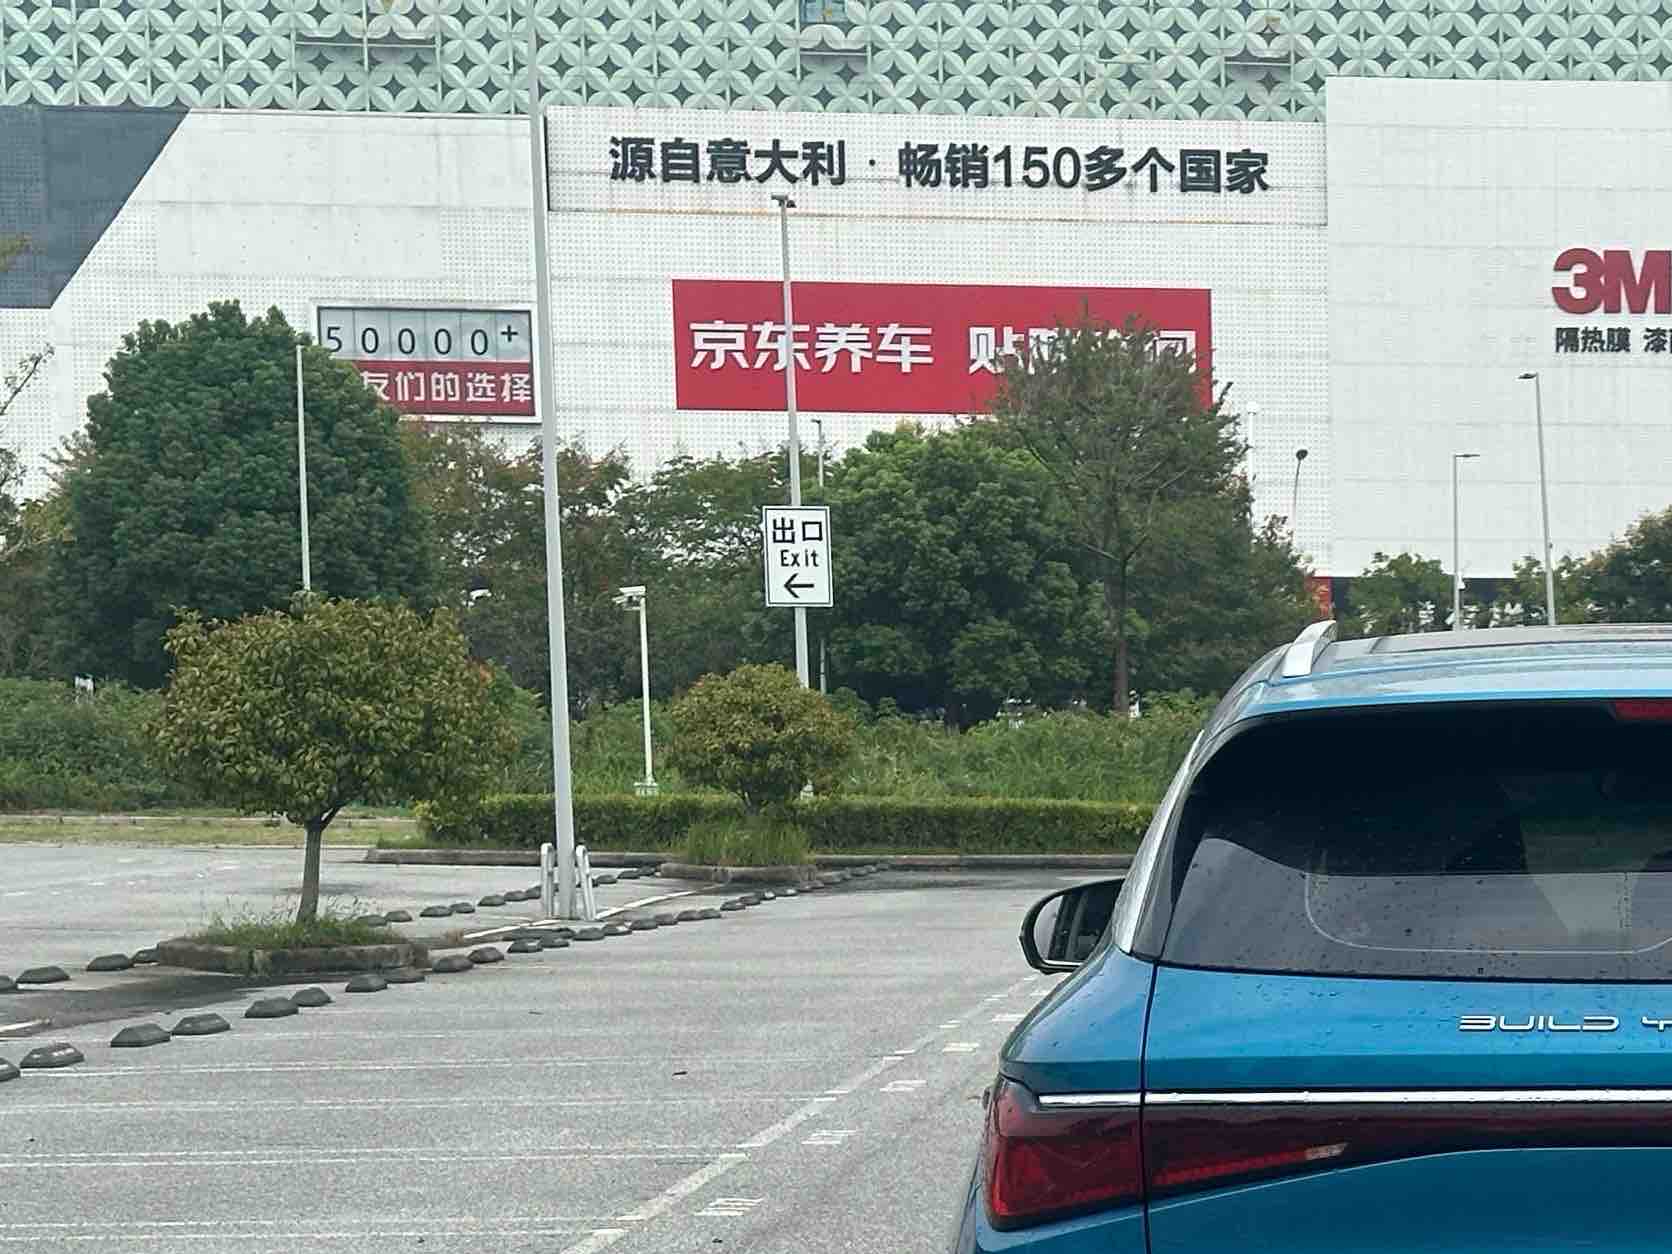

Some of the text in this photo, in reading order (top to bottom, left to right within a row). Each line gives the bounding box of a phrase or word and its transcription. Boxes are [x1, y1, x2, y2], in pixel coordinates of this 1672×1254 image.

[1551, 247, 1672, 315] 3M
[688, 319, 935, 374] 京东养车
[1555, 326, 1632, 354] 隔热膜
[772, 516, 824, 544] 出口
[780, 548, 820, 568] Exit
[1458, 1014, 1620, 1032] BUILD
